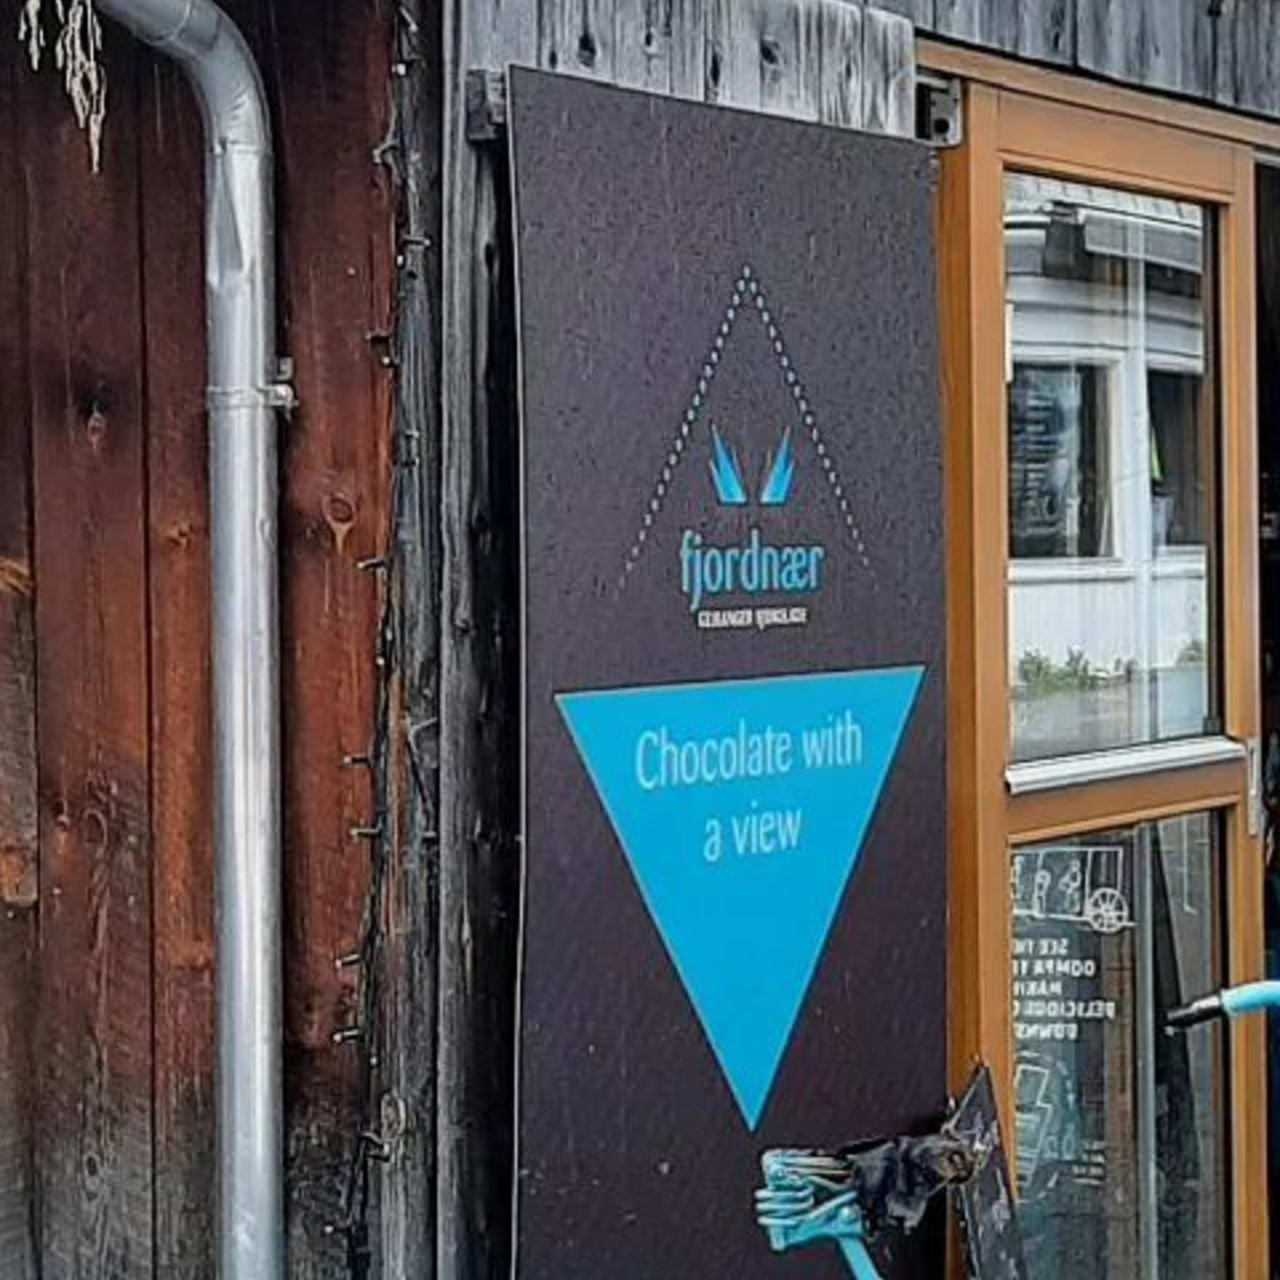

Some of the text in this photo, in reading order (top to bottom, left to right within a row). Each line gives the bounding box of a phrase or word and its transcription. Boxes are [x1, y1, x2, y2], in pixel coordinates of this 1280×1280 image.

[680, 529, 824, 612] fjordnær
[635, 708, 863, 790] Chocolate with
[704, 799, 802, 862] a view
